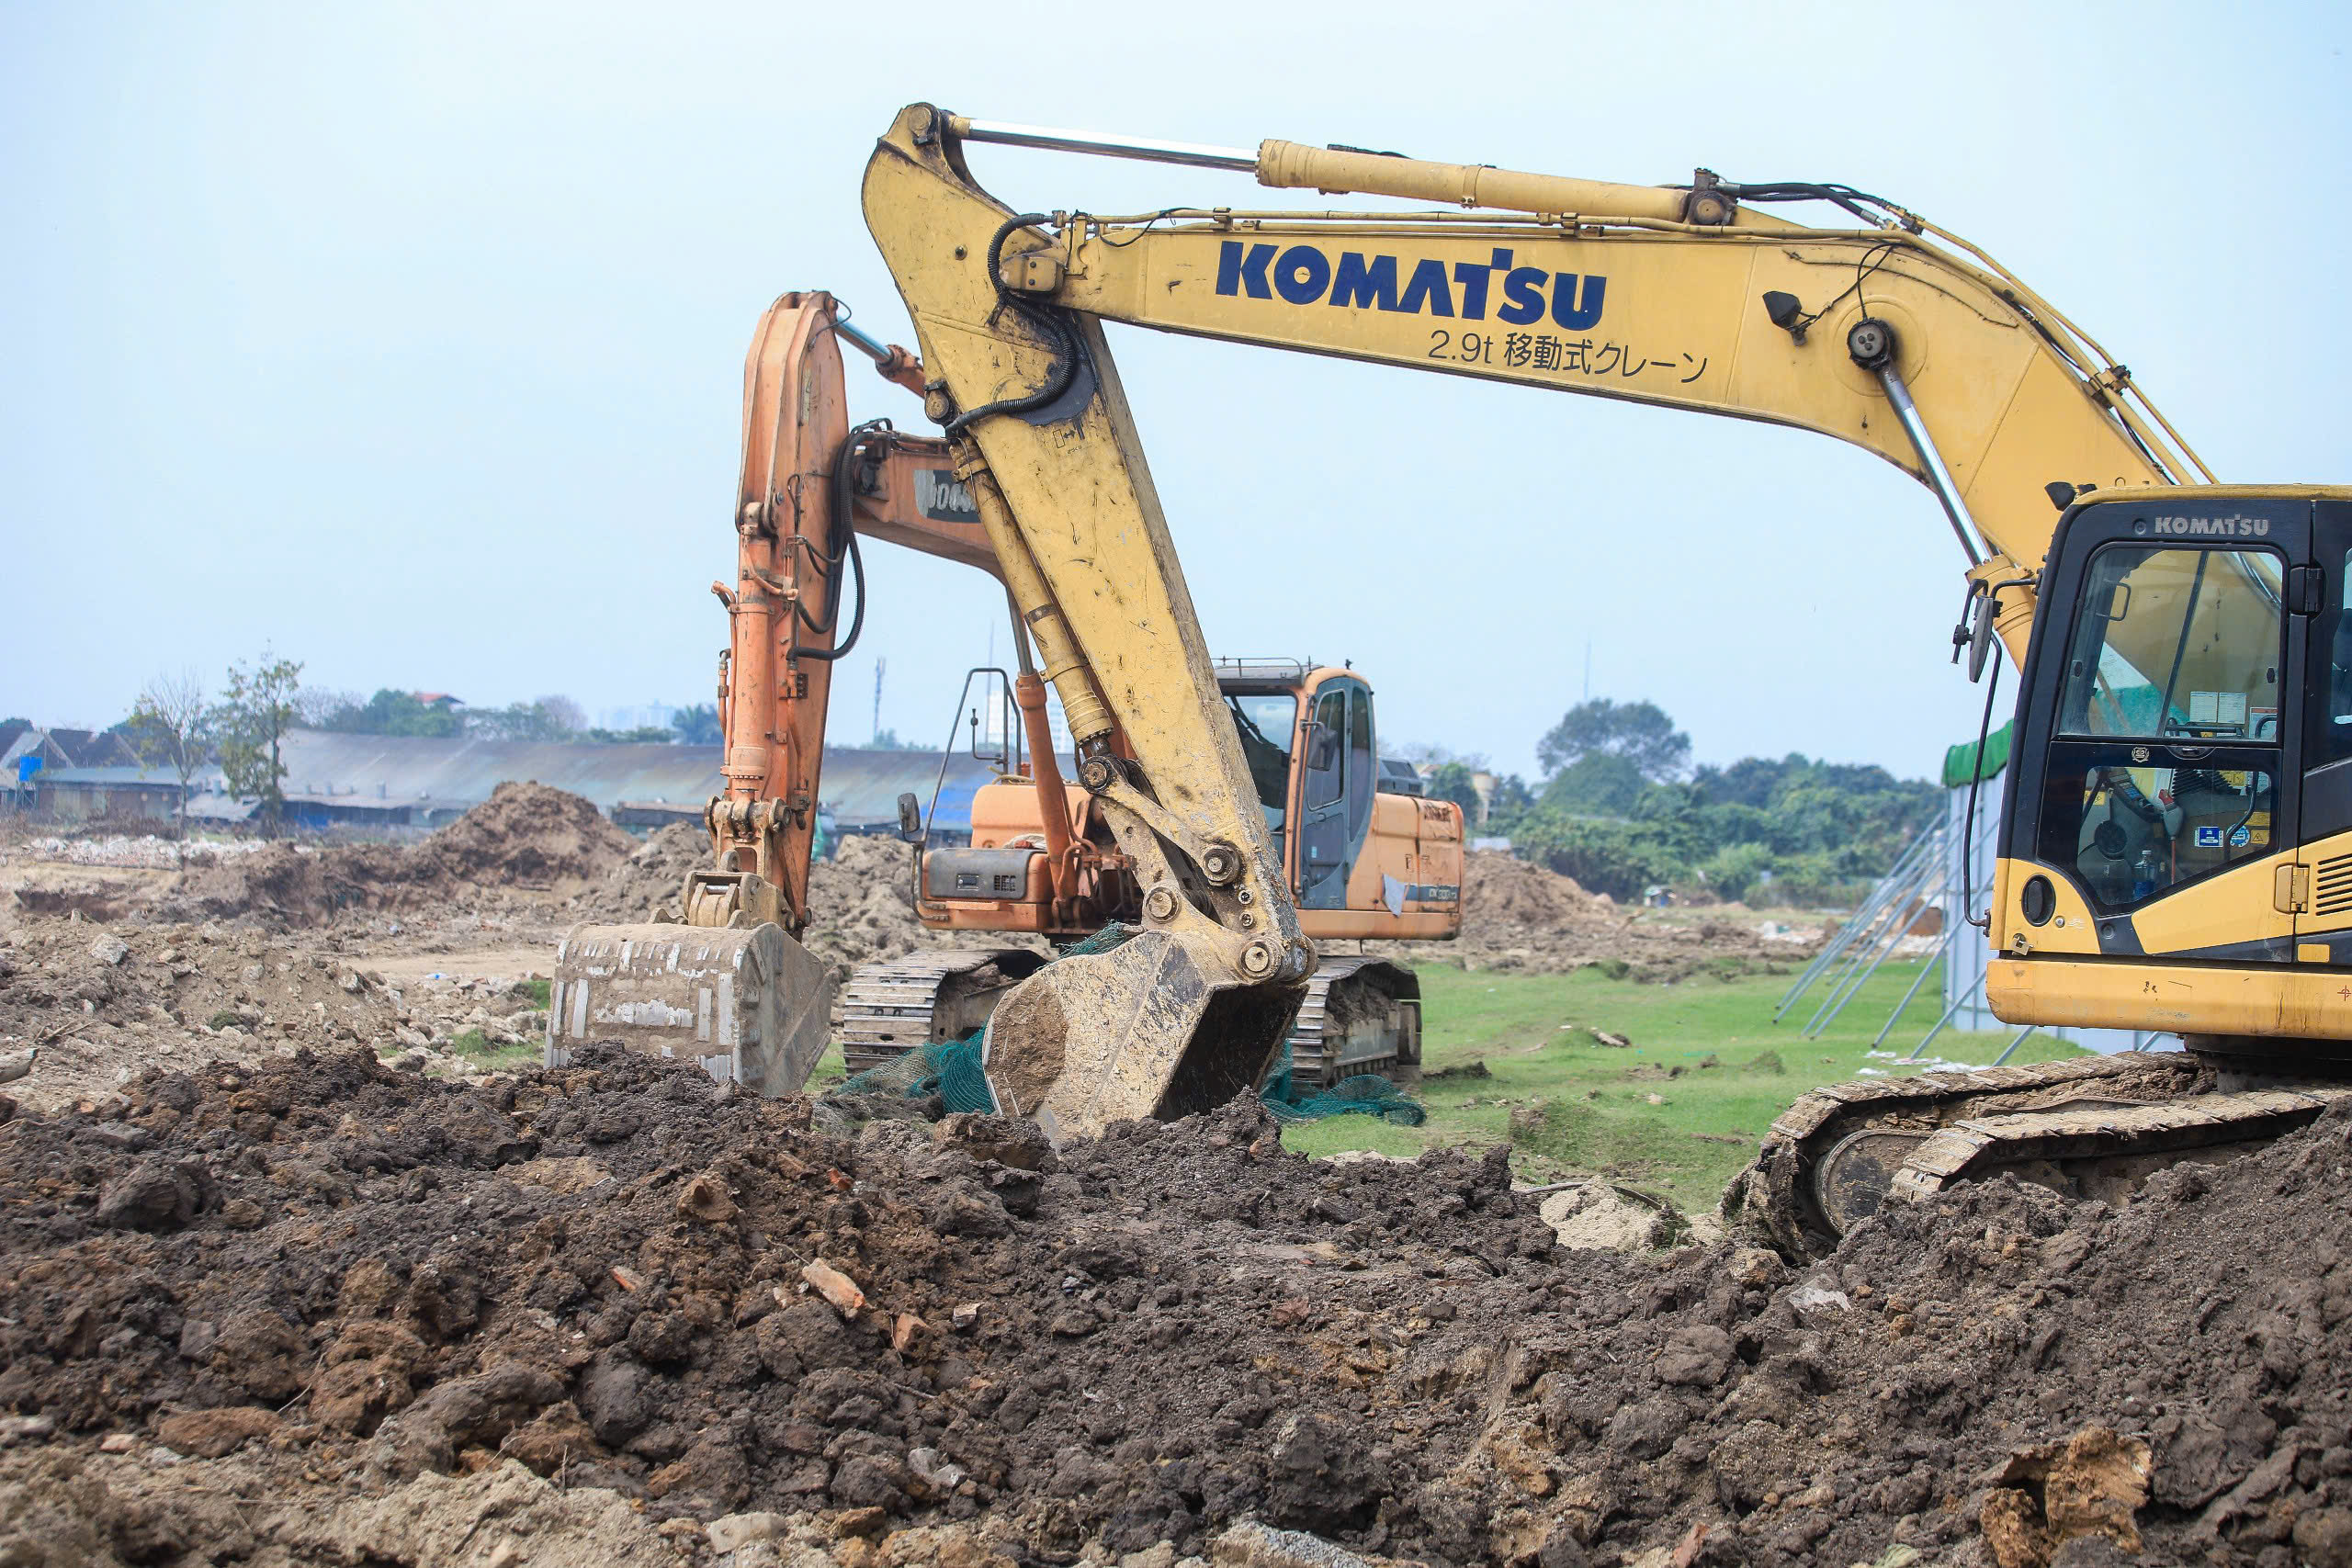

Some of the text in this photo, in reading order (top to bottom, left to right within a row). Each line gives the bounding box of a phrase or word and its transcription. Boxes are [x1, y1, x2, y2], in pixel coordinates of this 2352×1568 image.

[1216, 241, 1607, 331] KOMATSU
[1428, 329, 1708, 384] 2.9t 移動式クレーン
[2154, 513, 2268, 536] KOMATSU
